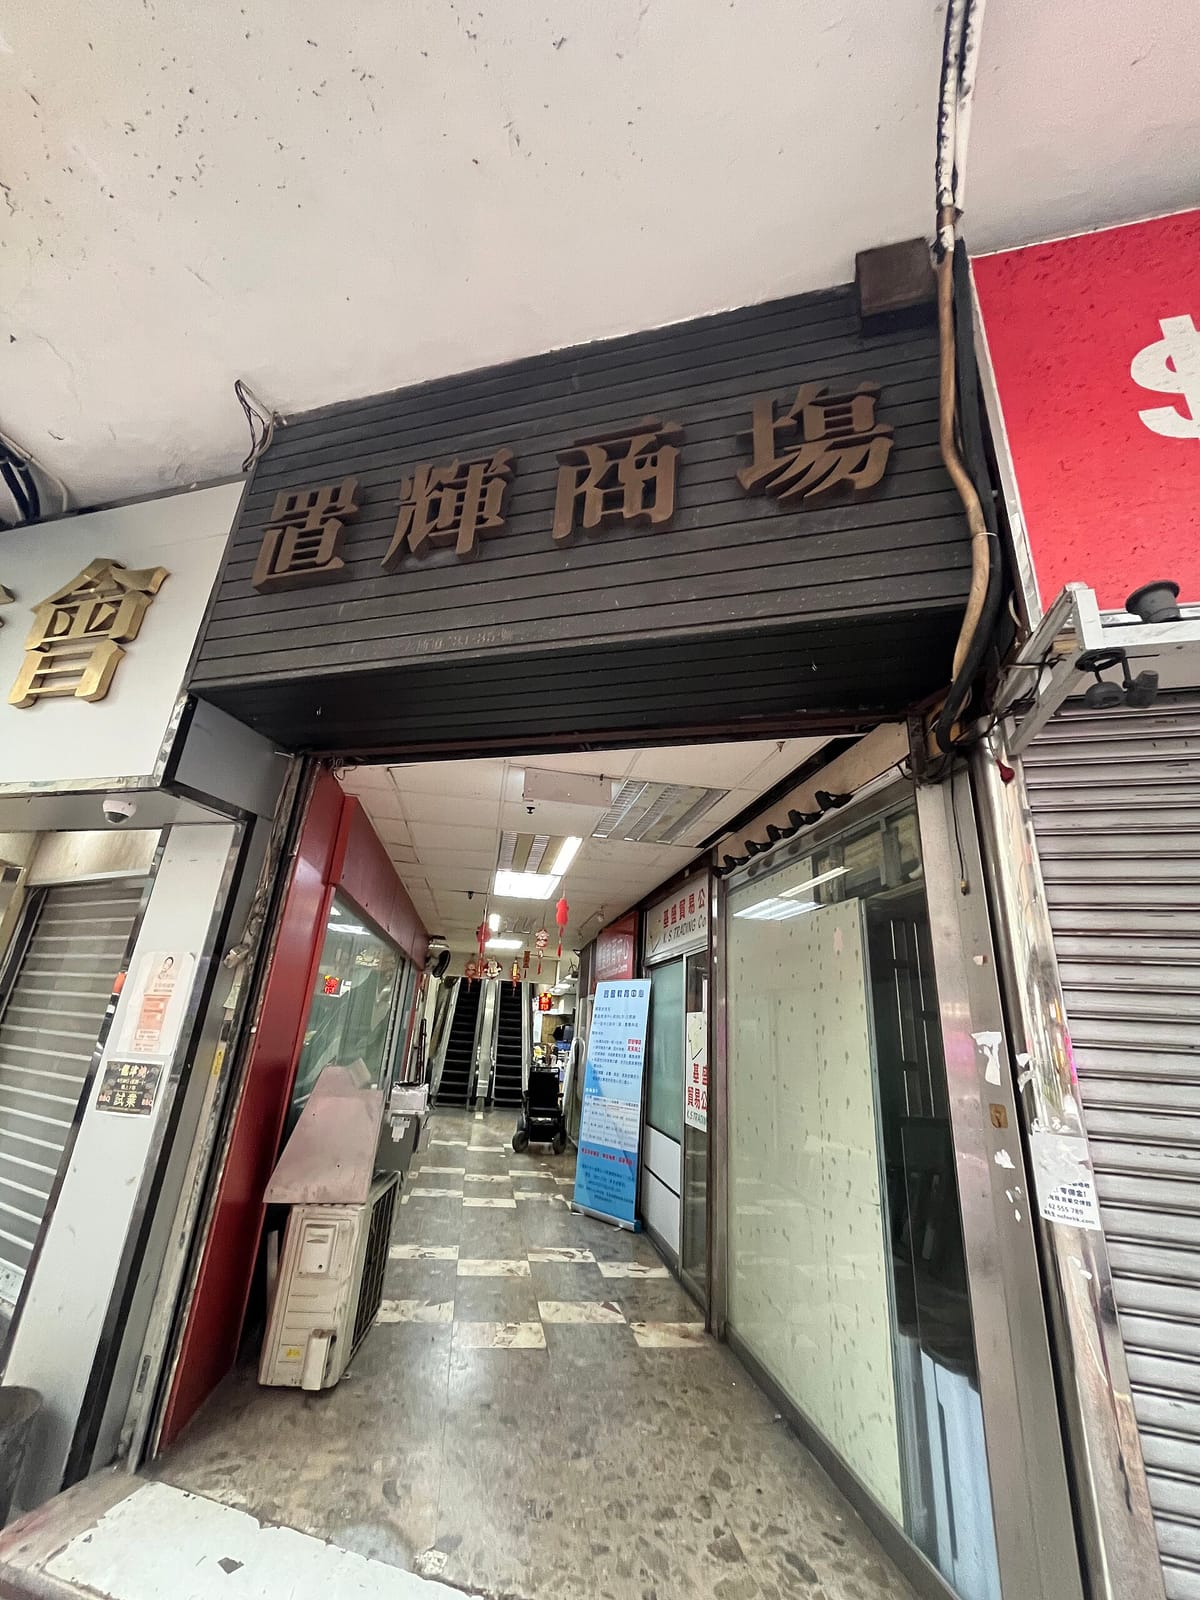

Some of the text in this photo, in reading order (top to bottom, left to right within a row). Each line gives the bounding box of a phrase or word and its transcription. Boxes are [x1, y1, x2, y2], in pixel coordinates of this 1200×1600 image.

[251, 381, 895, 593] 置輝商場
[0, 558, 172, 709] 會
[674, 918, 696, 939] TRADING
